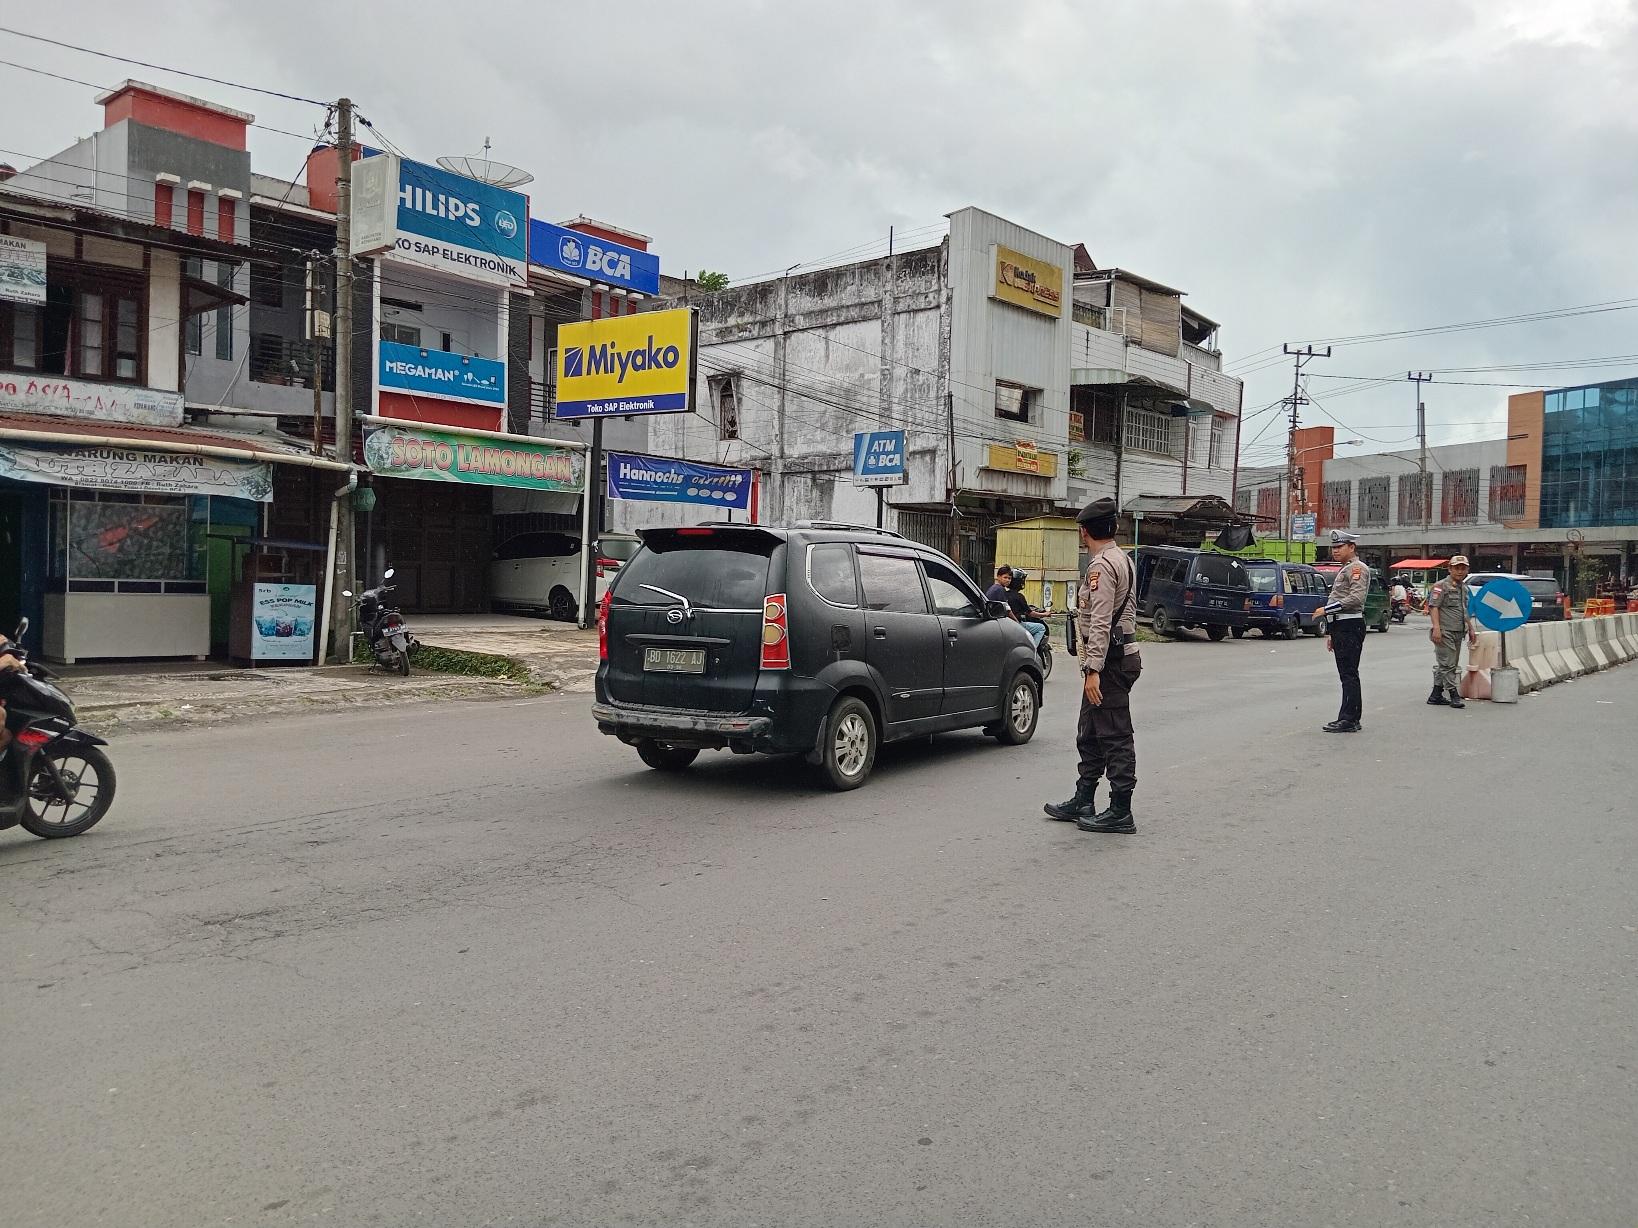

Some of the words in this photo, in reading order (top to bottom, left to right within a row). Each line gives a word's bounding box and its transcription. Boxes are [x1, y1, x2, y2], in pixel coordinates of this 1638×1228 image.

[414, 241, 439, 256] SAP
[443, 248, 516, 276] ELEKTRONIK
[585, 244, 631, 280] BCA
[586, 335, 680, 384] Miyako
[587, 404, 603, 413] Toko
[604, 402, 618, 412] SAP
[619, 399, 655, 411] Elektronik
[871, 439, 896, 452] ATM
[143, 454, 204, 467] MAKAN
[390, 437, 453, 471] SOTO
[457, 444, 572, 482] LAMONGAN
[878, 453, 901, 467] BCA
[619, 462, 684, 484] Hannochs
[650, 650, 661, 663] BD
[666, 651, 687, 665] 1622
[690, 651, 703, 665] AJ
